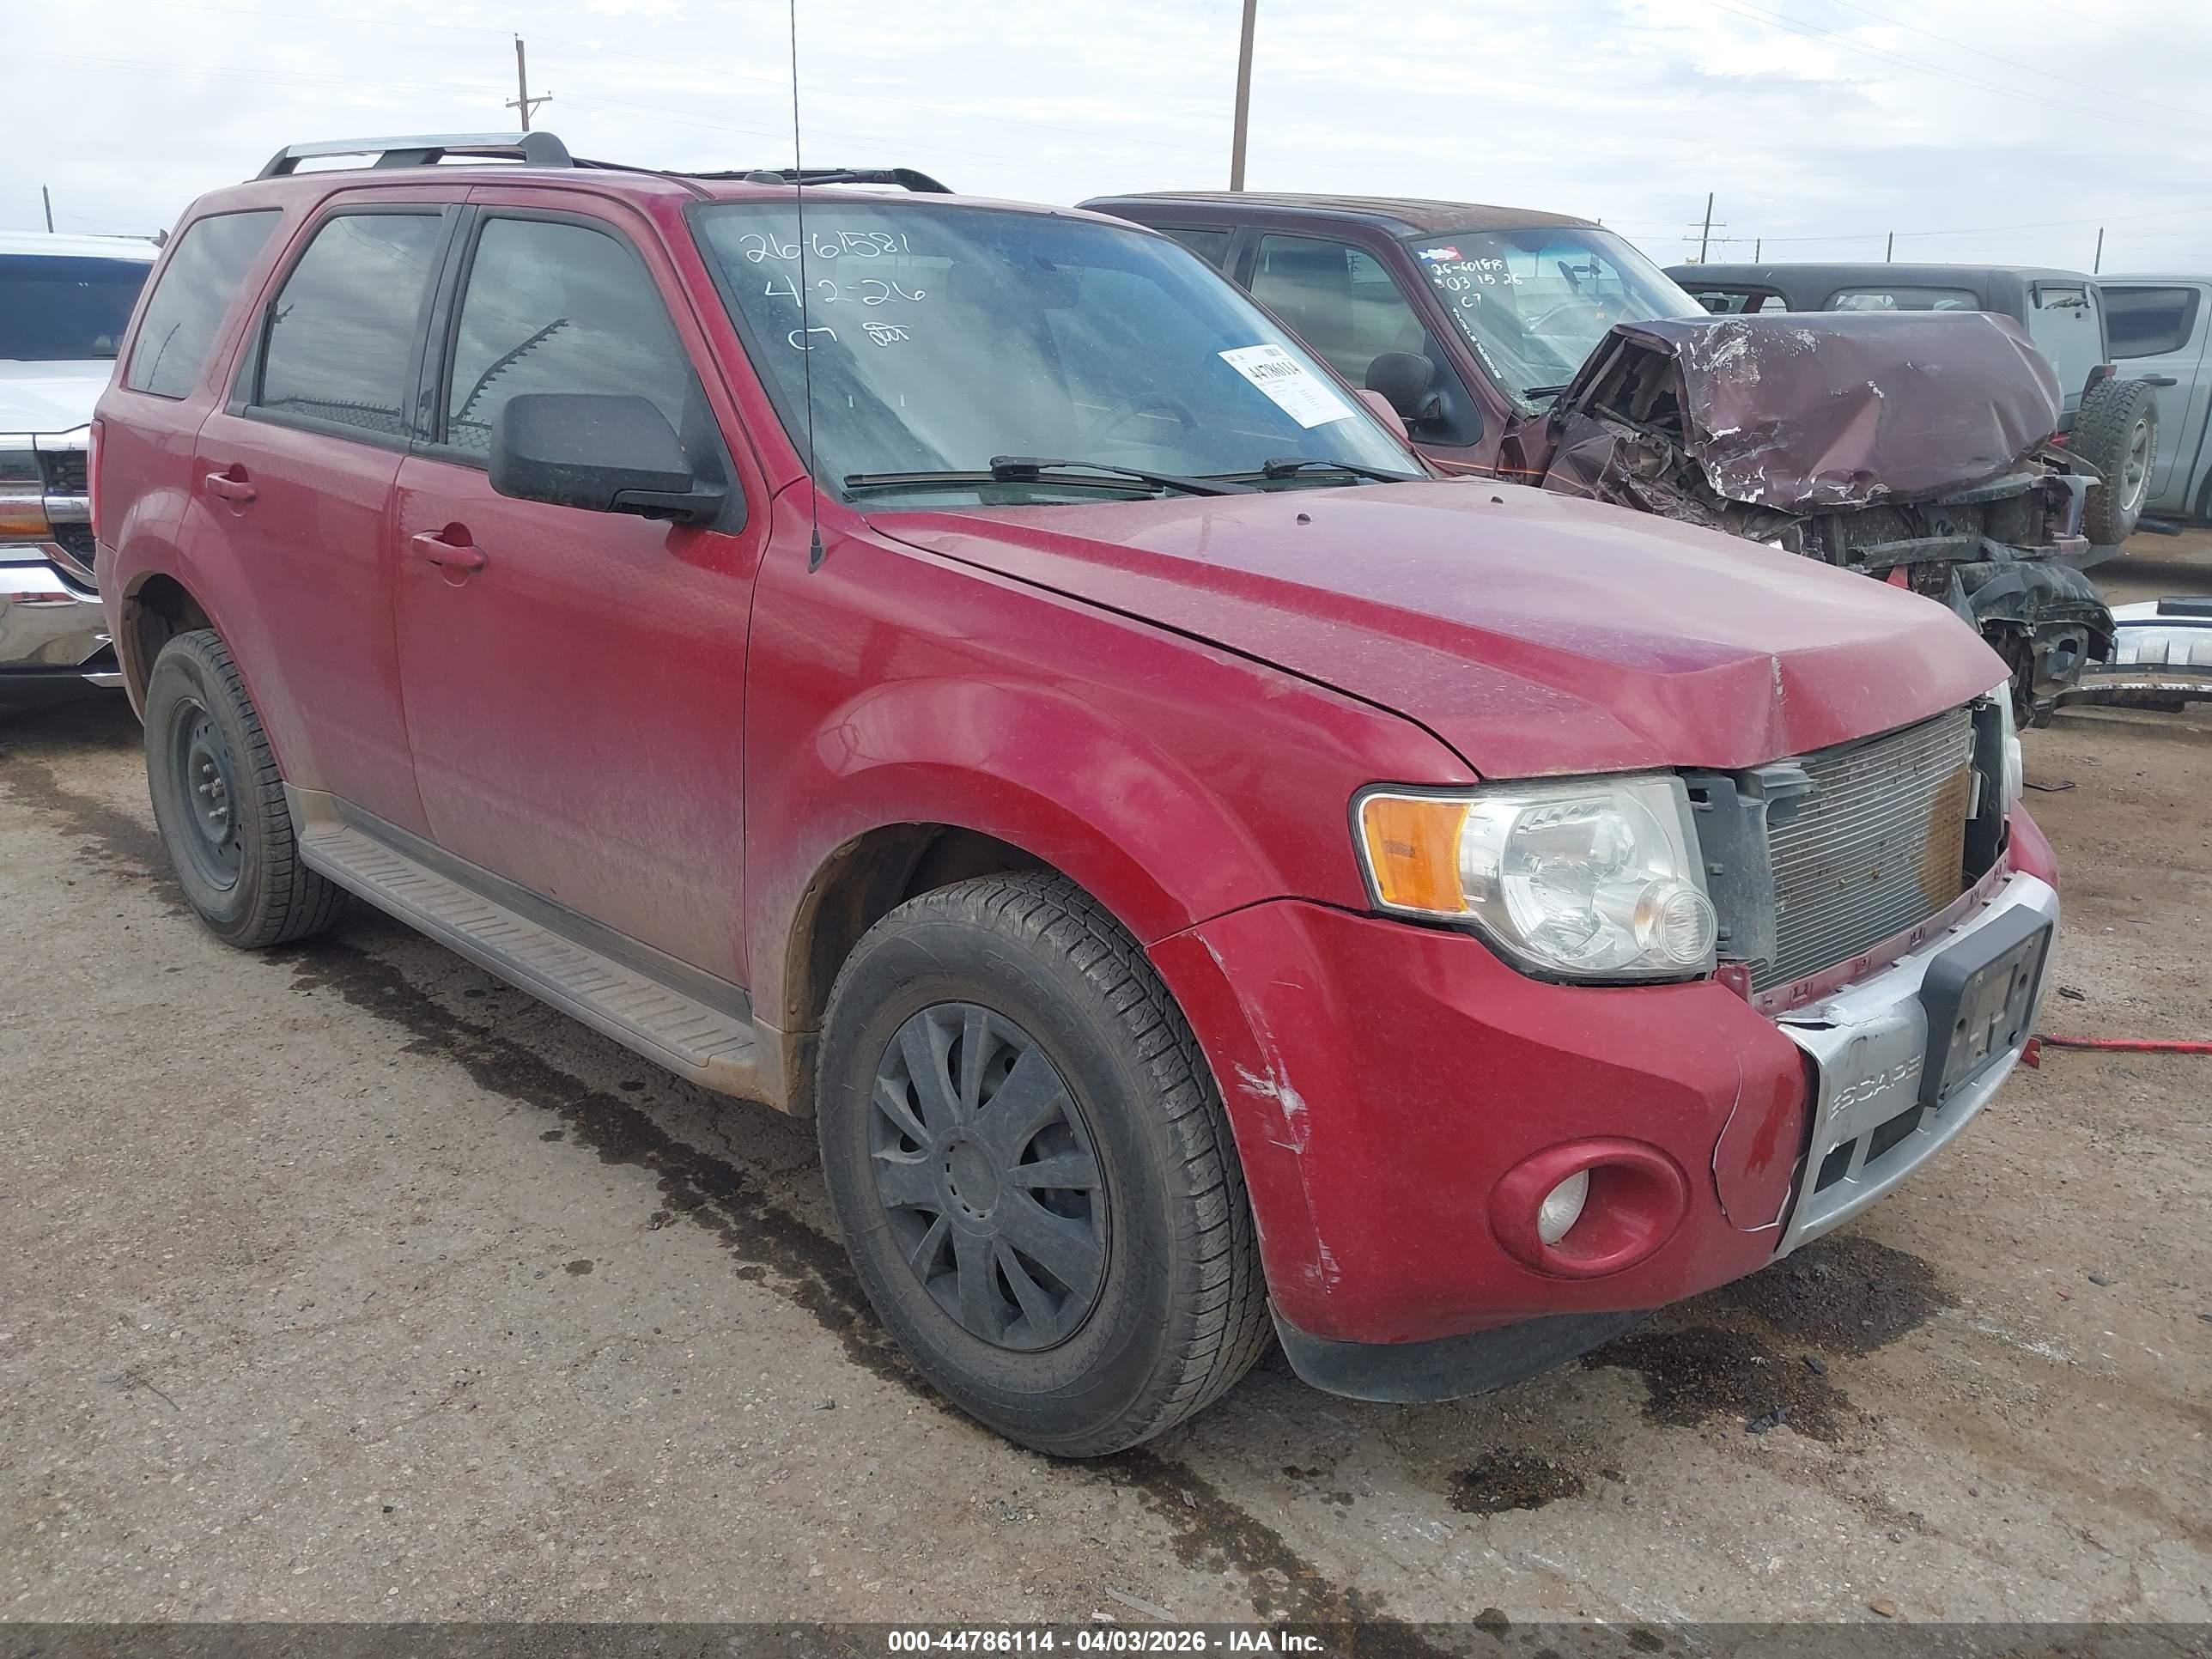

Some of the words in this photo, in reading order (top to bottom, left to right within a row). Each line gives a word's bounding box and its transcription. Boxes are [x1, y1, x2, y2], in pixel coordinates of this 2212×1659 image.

[1477, 273, 1496, 285] 15
[1504, 272, 1523, 286] 26
[1248, 361, 1303, 380] 44786114
[1830, 1054, 1923, 1121] ESCAPE
